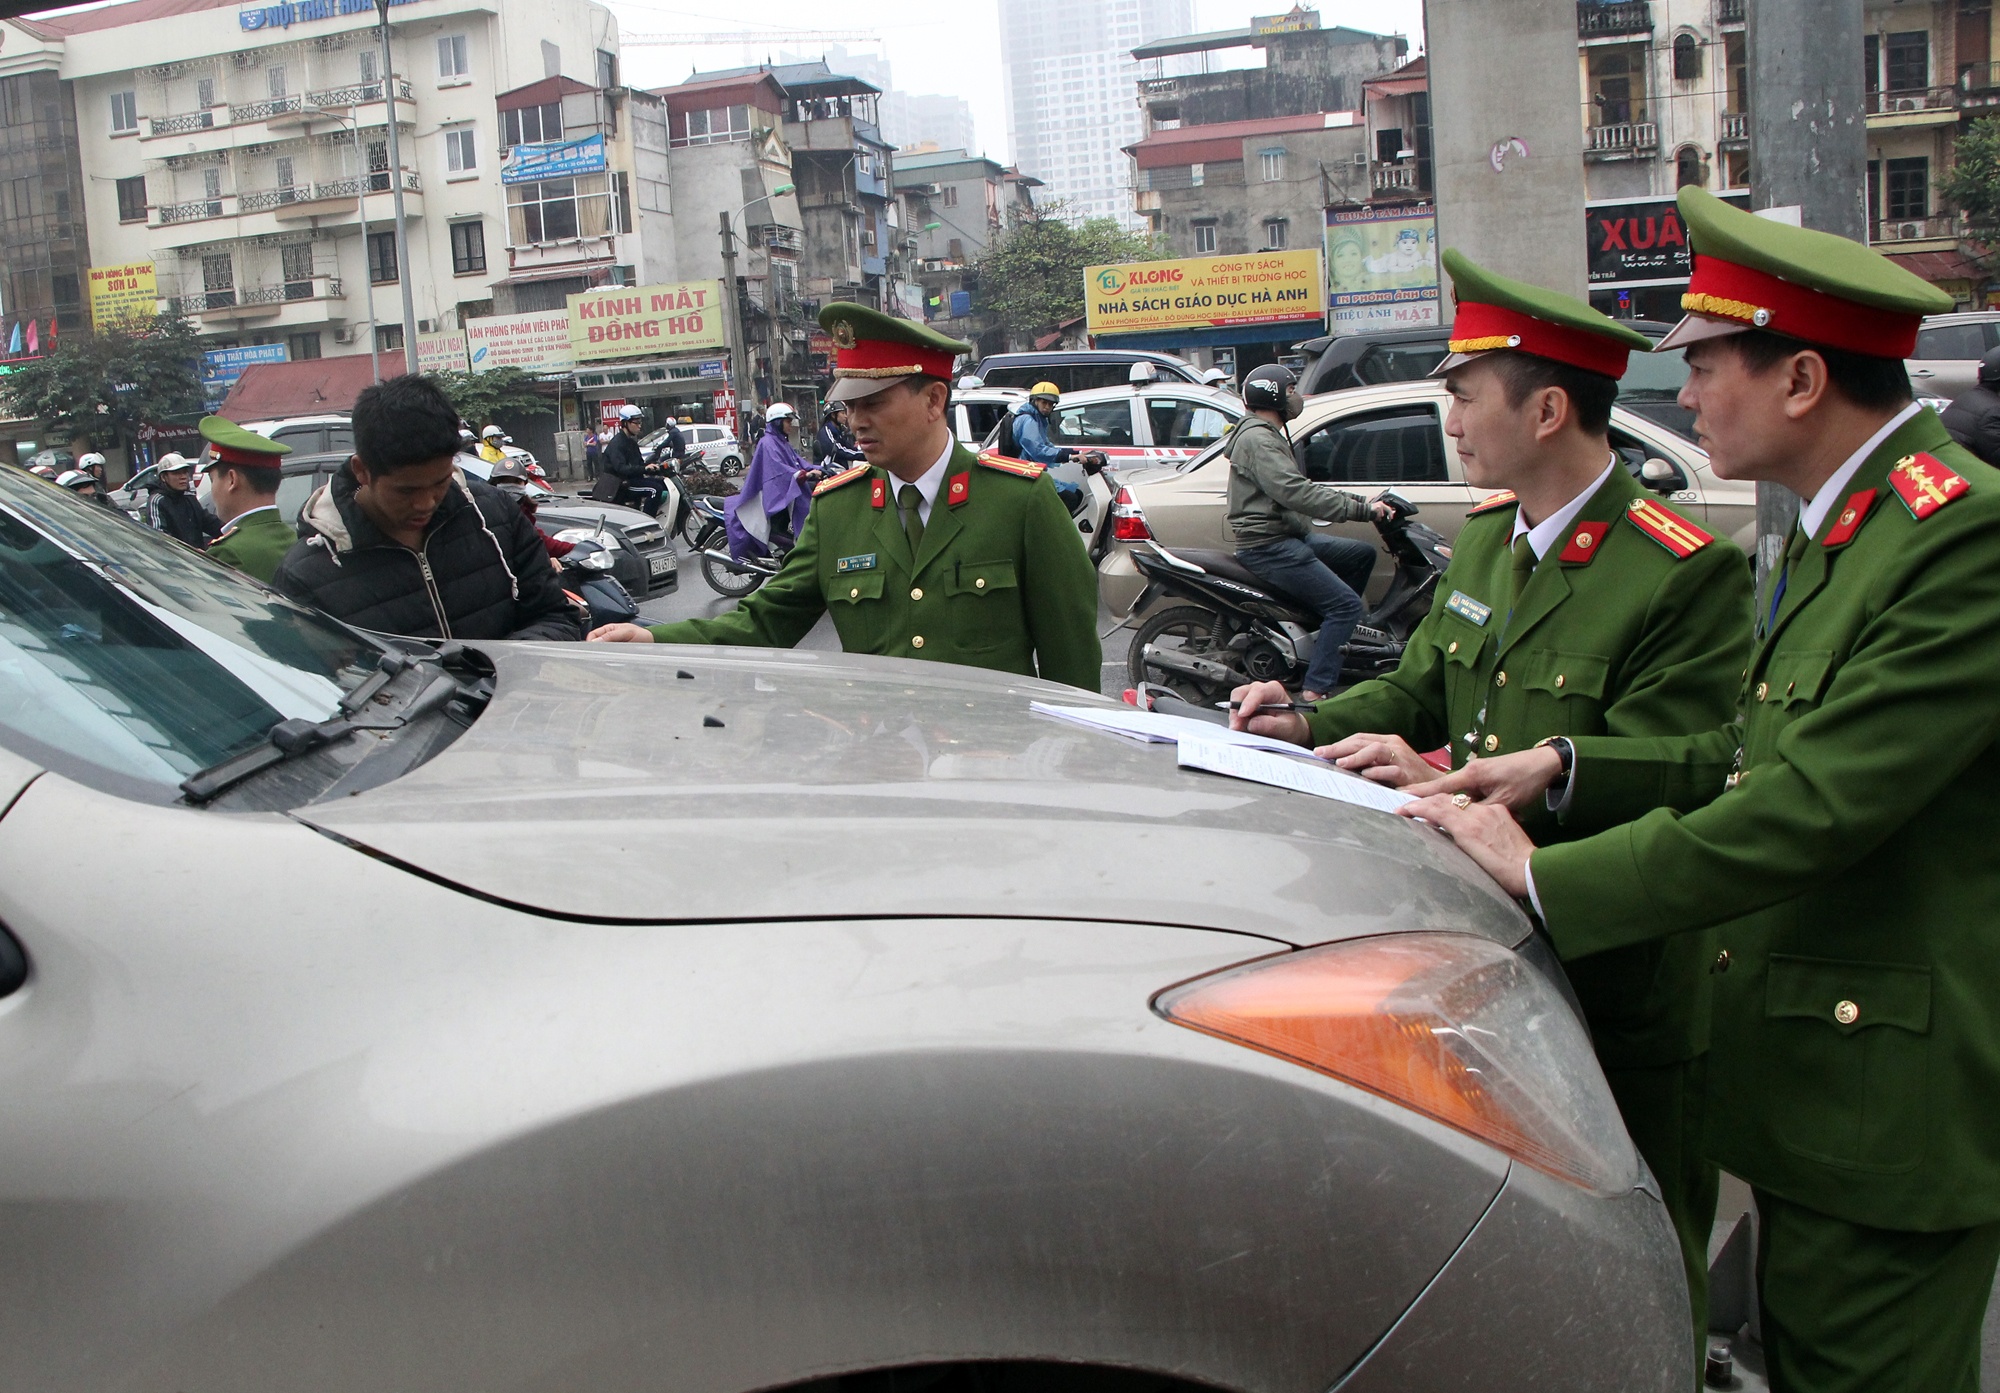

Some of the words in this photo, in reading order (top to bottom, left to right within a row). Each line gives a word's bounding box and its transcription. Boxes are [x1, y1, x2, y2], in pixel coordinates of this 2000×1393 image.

[1336, 211, 1374, 221] TRUNG
[1212, 262, 1243, 273] CÔNG
[1245, 262, 1255, 271] TY
[1258, 259, 1284, 270] SÁCH
[108, 279, 125, 292] SƠN
[127, 277, 138, 289] LA
[1191, 276, 1205, 287] VÀ
[1207, 274, 1229, 286] THIẾT
[1232, 276, 1240, 286] BỊ
[1242, 272, 1282, 283] TRƯỜNG
[1285, 270, 1307, 281] HỌC
[579, 297, 642, 320] KÍNH
[651, 286, 707, 312] MẮT
[1098, 298, 1128, 315] NHÀ
[1132, 296, 1170, 312] SÁCH
[1174, 292, 1212, 309] GIÁO
[1217, 292, 1247, 308] DỤC
[1252, 287, 1272, 303] HÀ
[1276, 288, 1308, 301] ANH
[1337, 295, 1350, 305] IN
[1352, 291, 1392, 303] PHÓNG
[1394, 290, 1419, 301] ẢNH
[1285, 305, 1307, 313] CASIO
[1335, 309, 1364, 321] HIỆU
[1367, 307, 1392, 319] ẢNH
[468, 325, 484, 339] VĂN
[485, 323, 509, 337] PHÒNG
[510, 318, 532, 335] PHẨM
[551, 317, 569, 331] PHÁT
[588, 318, 660, 344] ĐỒNG
[668, 310, 704, 335] HỒ
[227, 350, 243, 361] THẤT
[244, 349, 258, 360] HÒA
[259, 348, 275, 358] PHÁT
[579, 373, 605, 387] KÍNH
[607, 369, 641, 384] THUỐC
